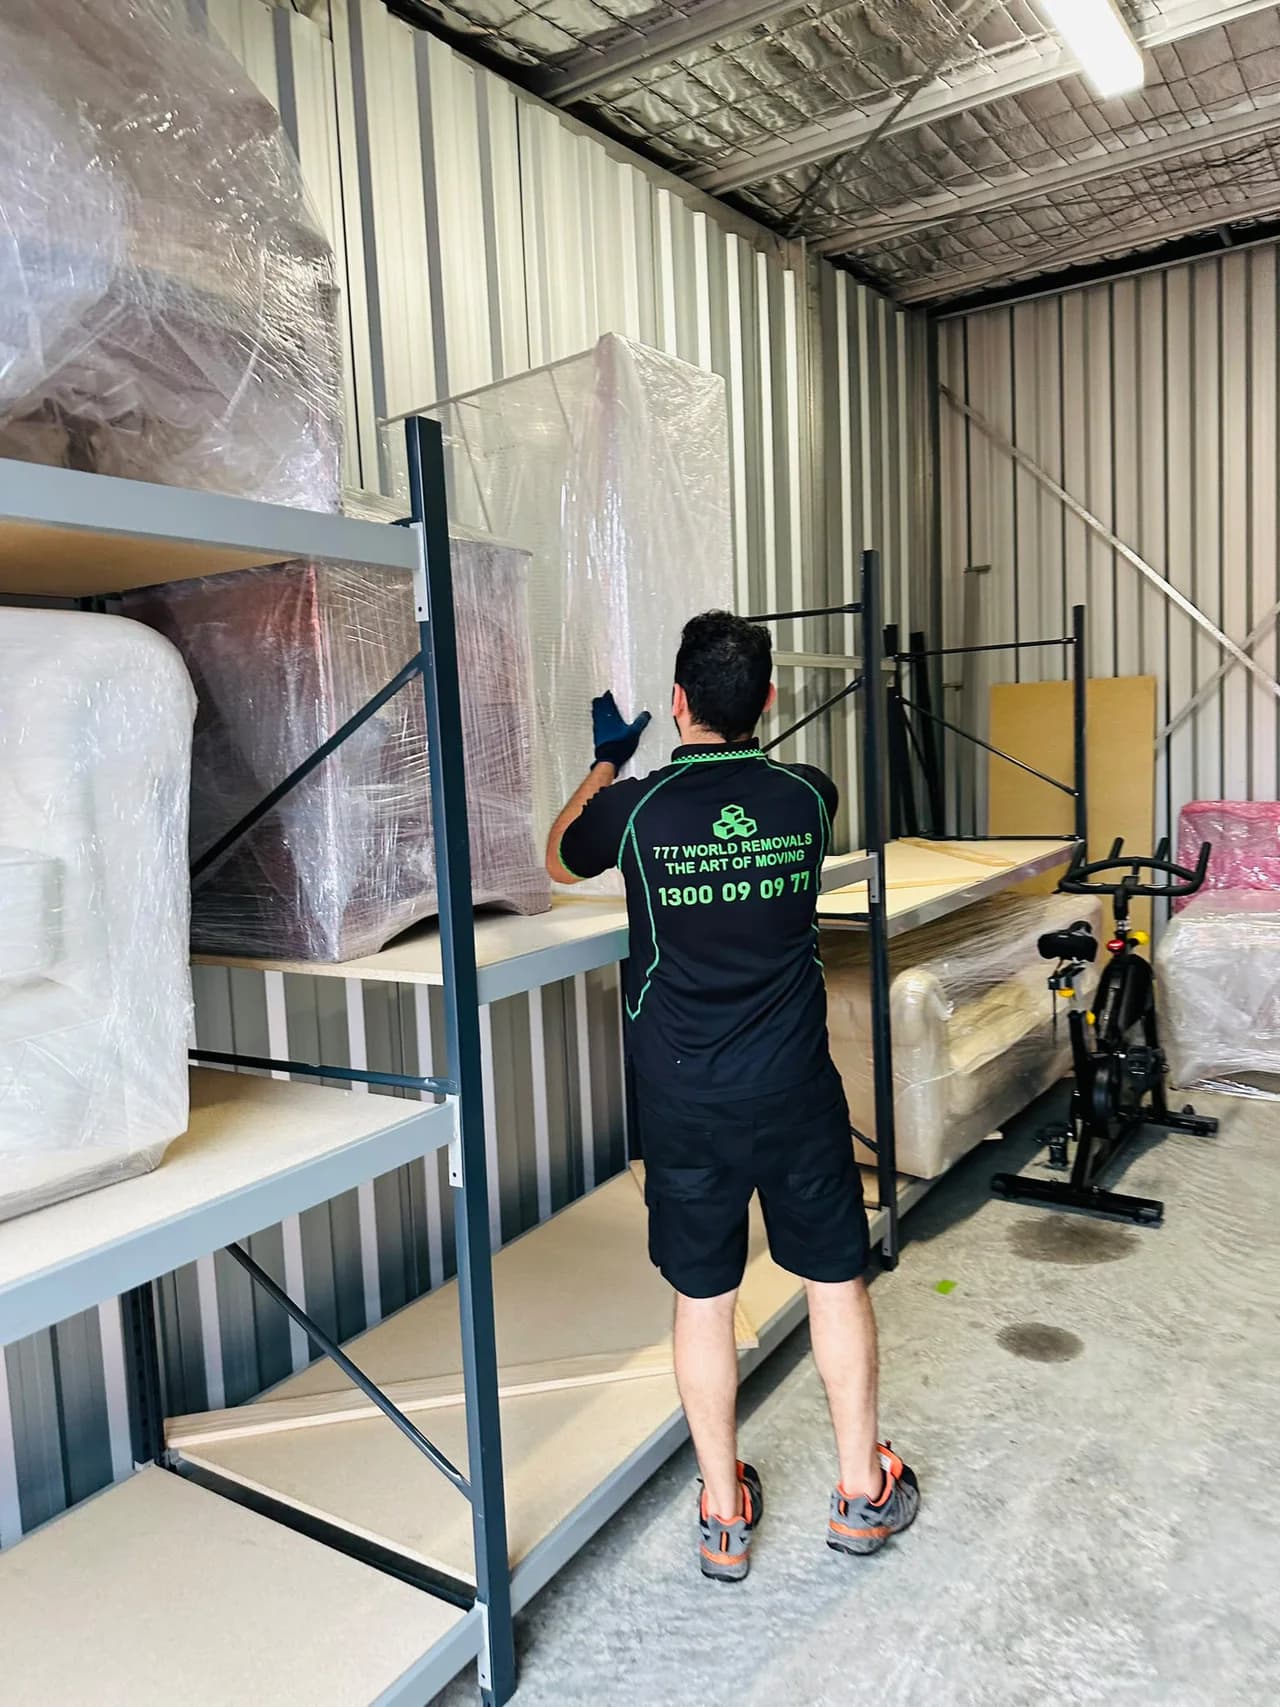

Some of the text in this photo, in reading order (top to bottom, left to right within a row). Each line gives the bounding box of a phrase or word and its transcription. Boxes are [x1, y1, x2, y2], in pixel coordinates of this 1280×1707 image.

[653, 833, 813, 859] 777 WORLD REMOVALS
[665, 850, 805, 875] THE ART OF MOVING
[658, 871, 810, 906] 1300 09 09 77
